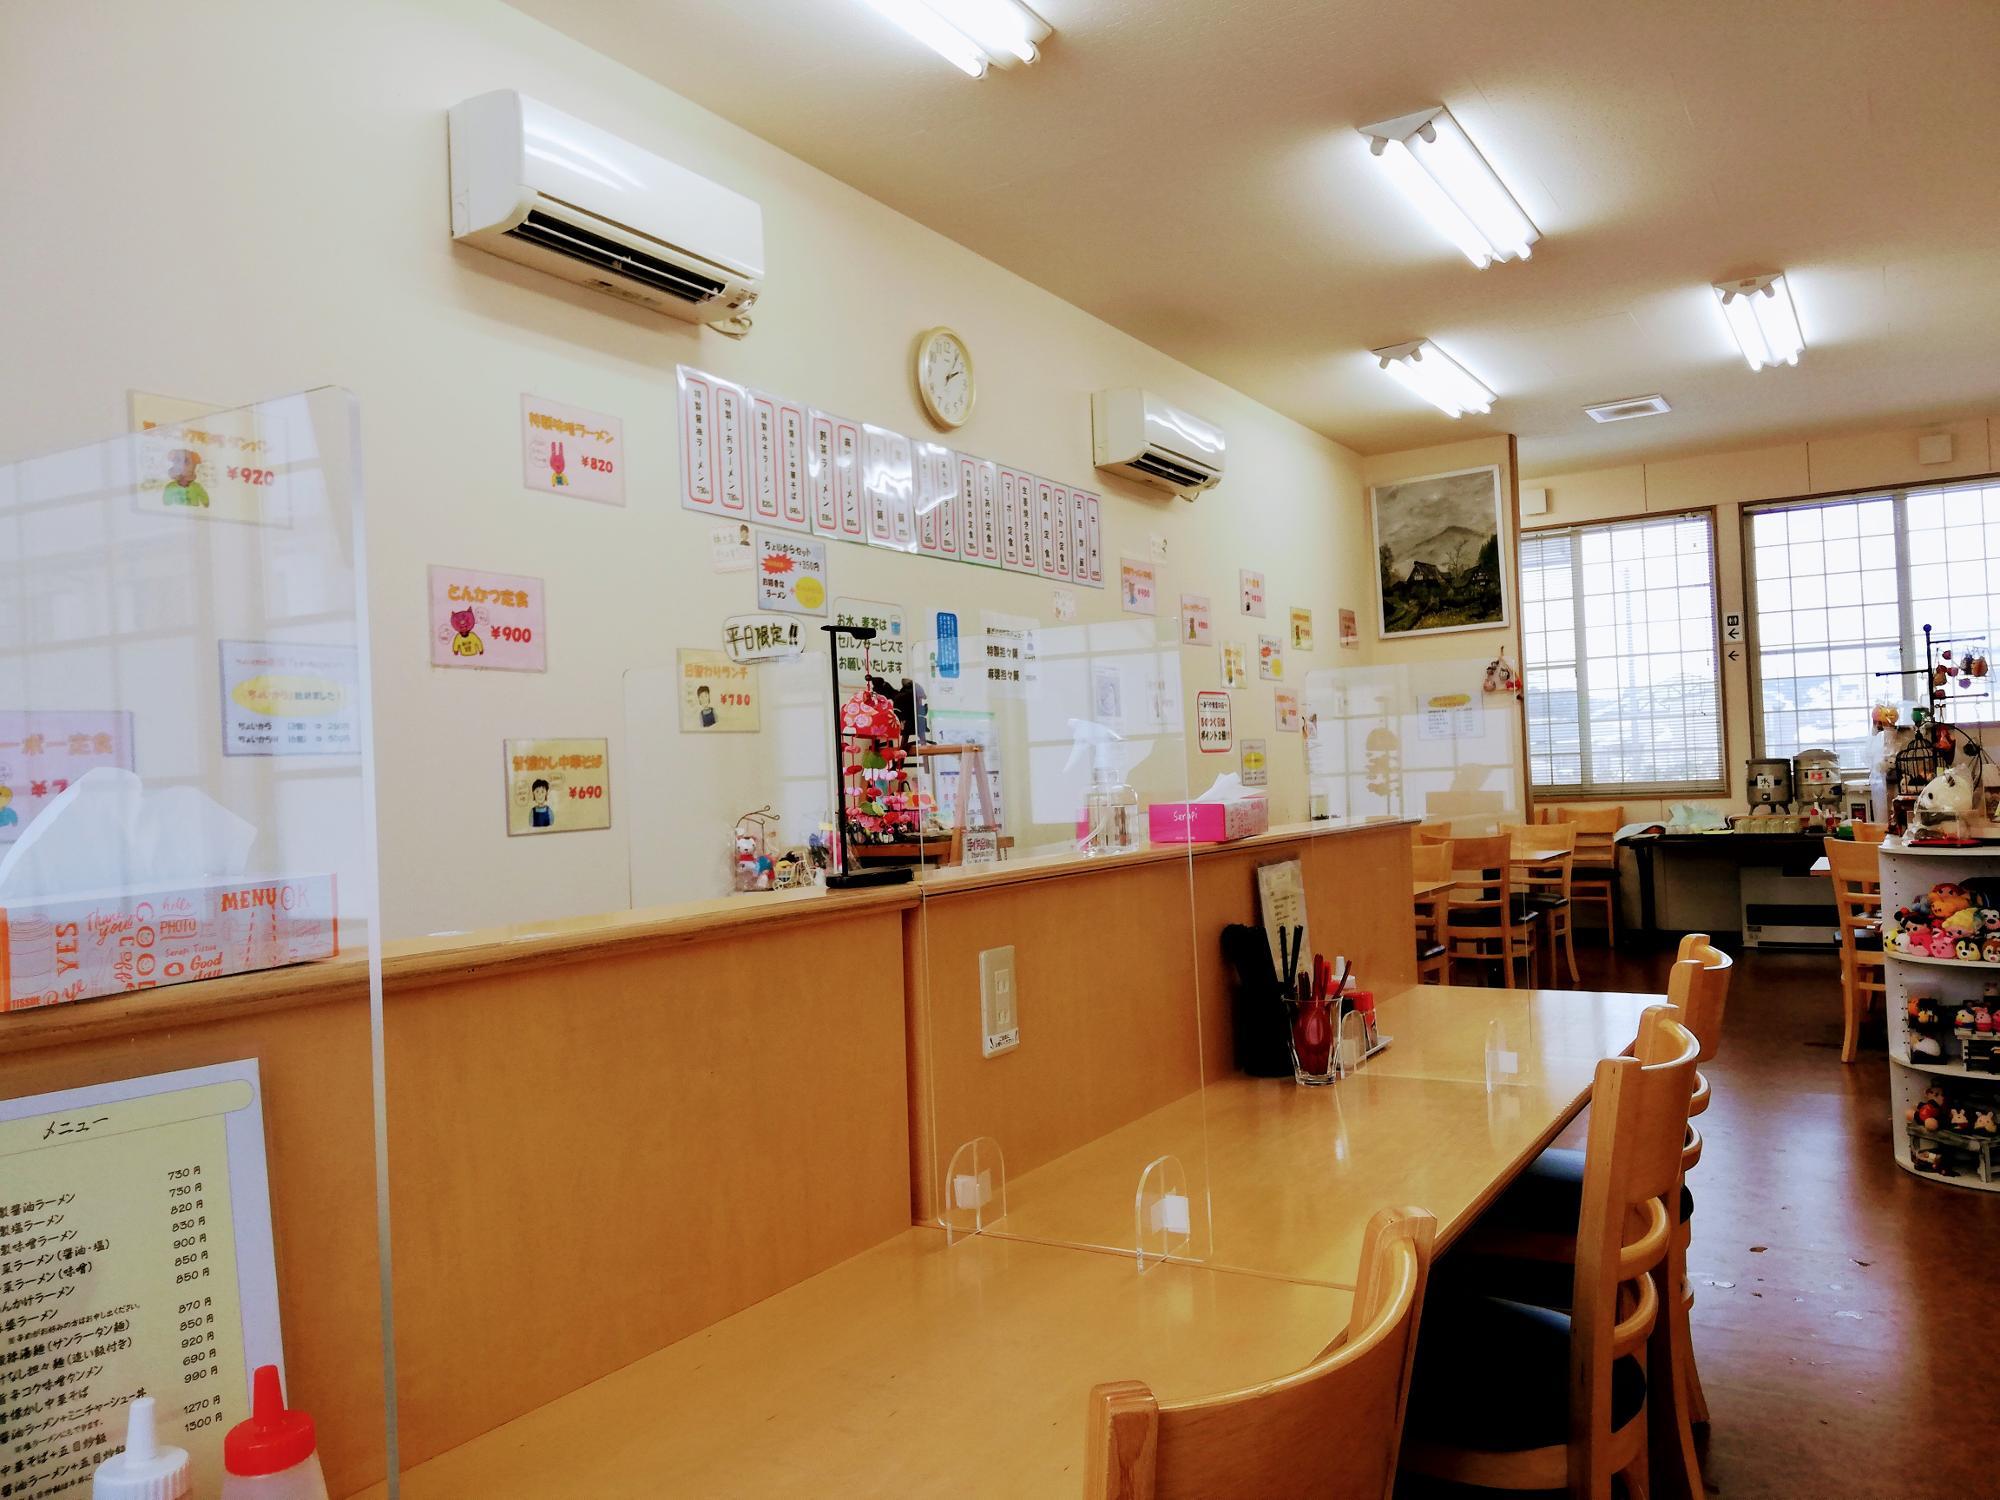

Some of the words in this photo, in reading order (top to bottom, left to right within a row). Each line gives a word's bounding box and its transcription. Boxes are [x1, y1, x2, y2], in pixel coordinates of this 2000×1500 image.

[581, 455, 614, 473] ¥820
[227, 464, 274, 487] ¥920
[447, 583, 529, 608] とんかつ定食
[766, 589, 787, 599] ラーメン
[490, 624, 532, 643] ¥900
[725, 622, 799, 656] 平日限定!!
[684, 663, 748, 680] 日替わりランチ
[838, 657, 903, 674] お願いいたします
[720, 694, 751, 706] ¥780
[568, 785, 602, 800] ¥690
[221, 887, 277, 912] MENU
[160, 919, 197, 934] PHOTO
[55, 922, 80, 976] YES
[190, 952, 223, 971] Good
[43, 1117, 109, 1140] メニュー
